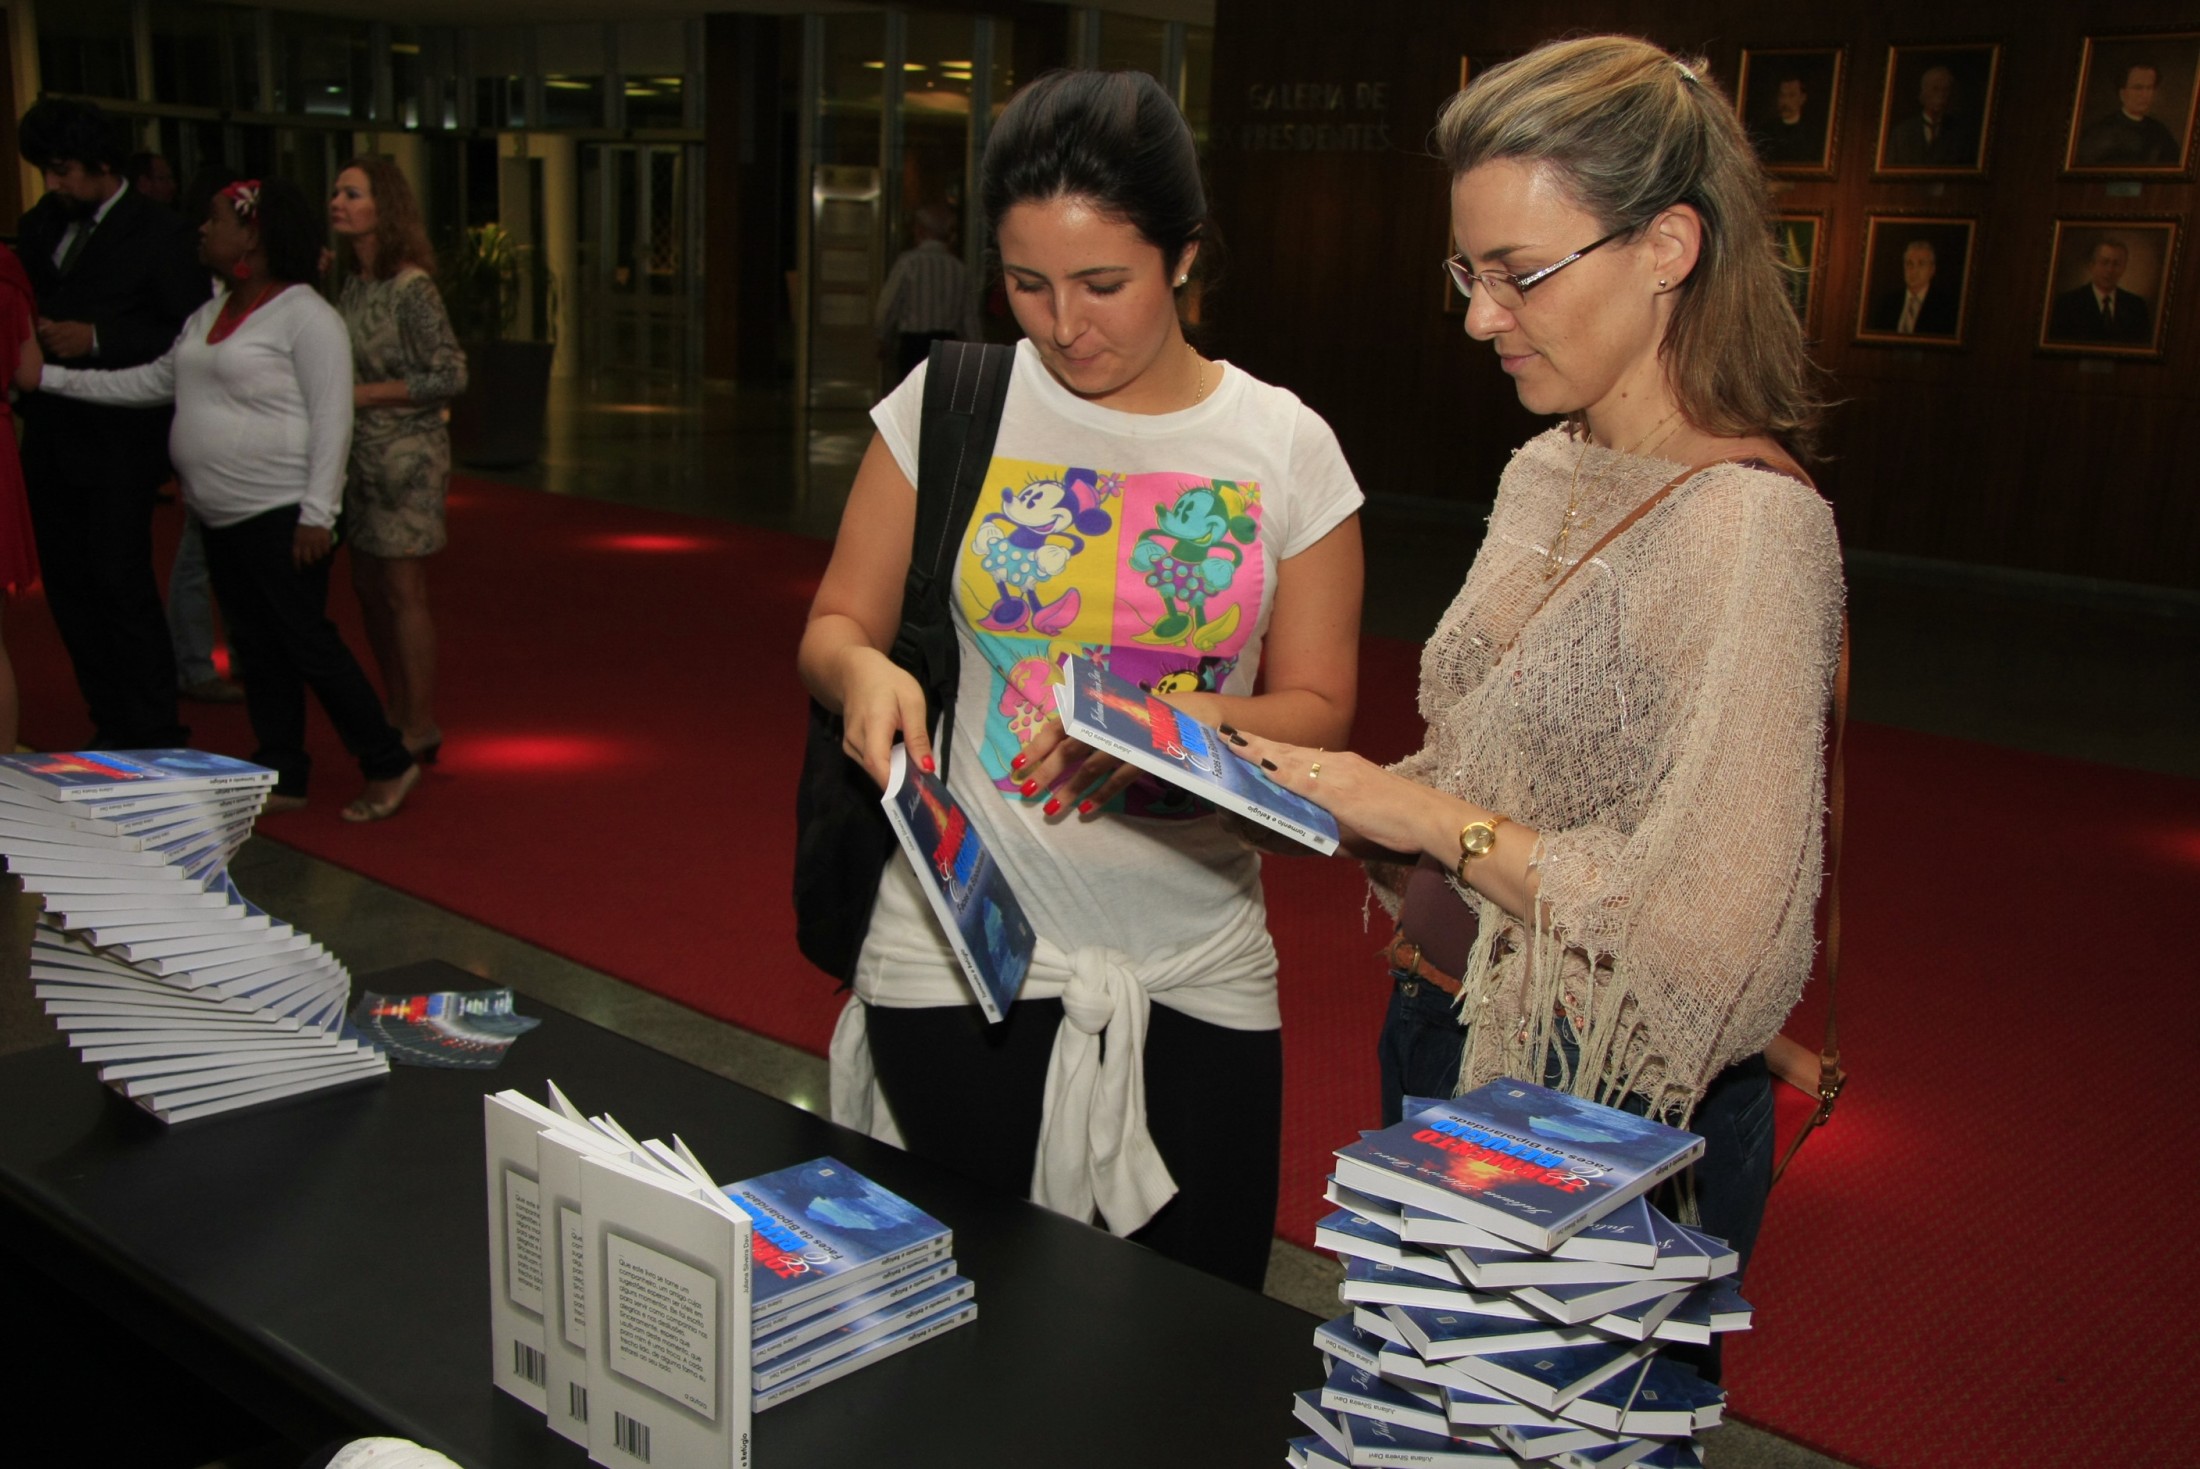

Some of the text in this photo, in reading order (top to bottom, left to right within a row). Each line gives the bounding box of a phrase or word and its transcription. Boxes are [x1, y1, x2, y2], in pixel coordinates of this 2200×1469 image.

[1249, 82, 1390, 110] GALERIA DE
[1080, 728, 1093, 738] Davi
[1113, 743, 1132, 754] Juliana
[1278, 820, 1306, 837] Tormento
[1448, 1115, 1614, 1172] Faces da Bipolaridade
[1411, 1130, 1584, 1194] TORMENTO
[742, 1191, 844, 1260] Faces da Bipolaridade
[619, 1259, 631, 1268] Que
[632, 1264, 644, 1273] este
[645, 1269, 656, 1279] livro
[664, 1278, 679, 1289] torne
[680, 1286, 689, 1294] um
[619, 1268, 657, 1289] companheiro,
[669, 1290, 686, 1302] amigo
[687, 1298, 701, 1309] cujas
[619, 1277, 646, 1292] sugestões
[647, 1289, 671, 1303] esperam
[694, 1310, 703, 1318] em
[619, 1286, 637, 1297] alguns
[639, 1294, 669, 1311] momentos.
[687, 1316, 704, 1328] escrito
[620, 1303, 640, 1315] alegrias
[647, 1314, 657, 1322] nas
[620, 1295, 708, 1339] para servir como companhia nas
[620, 1328, 633, 1338] para
[635, 1334, 646, 1343] mim
[653, 1344, 665, 1353] uma
[688, 1360, 703, 1372] cada
[646, 1332, 661, 1341] deste
[662, 1339, 689, 1356] momento,
[691, 1353, 702, 1362] que
[660, 1329, 678, 1342] espero
[680, 1338, 690, 1347] que
[1326, 1339, 1373, 1365] Juliana Silveira Davi
[620, 1346, 638, 1357] estarei
[649, 1358, 657, 1366] seu
[620, 1336, 638, 1348] trecho
[661, 1355, 681, 1369] alguma
[682, 1364, 698, 1378] forma
[690, 1396, 707, 1409] autora
[1334, 1396, 1396, 1414] Juliana Silveira Davi
[740, 1433, 749, 1461] Refúgio
